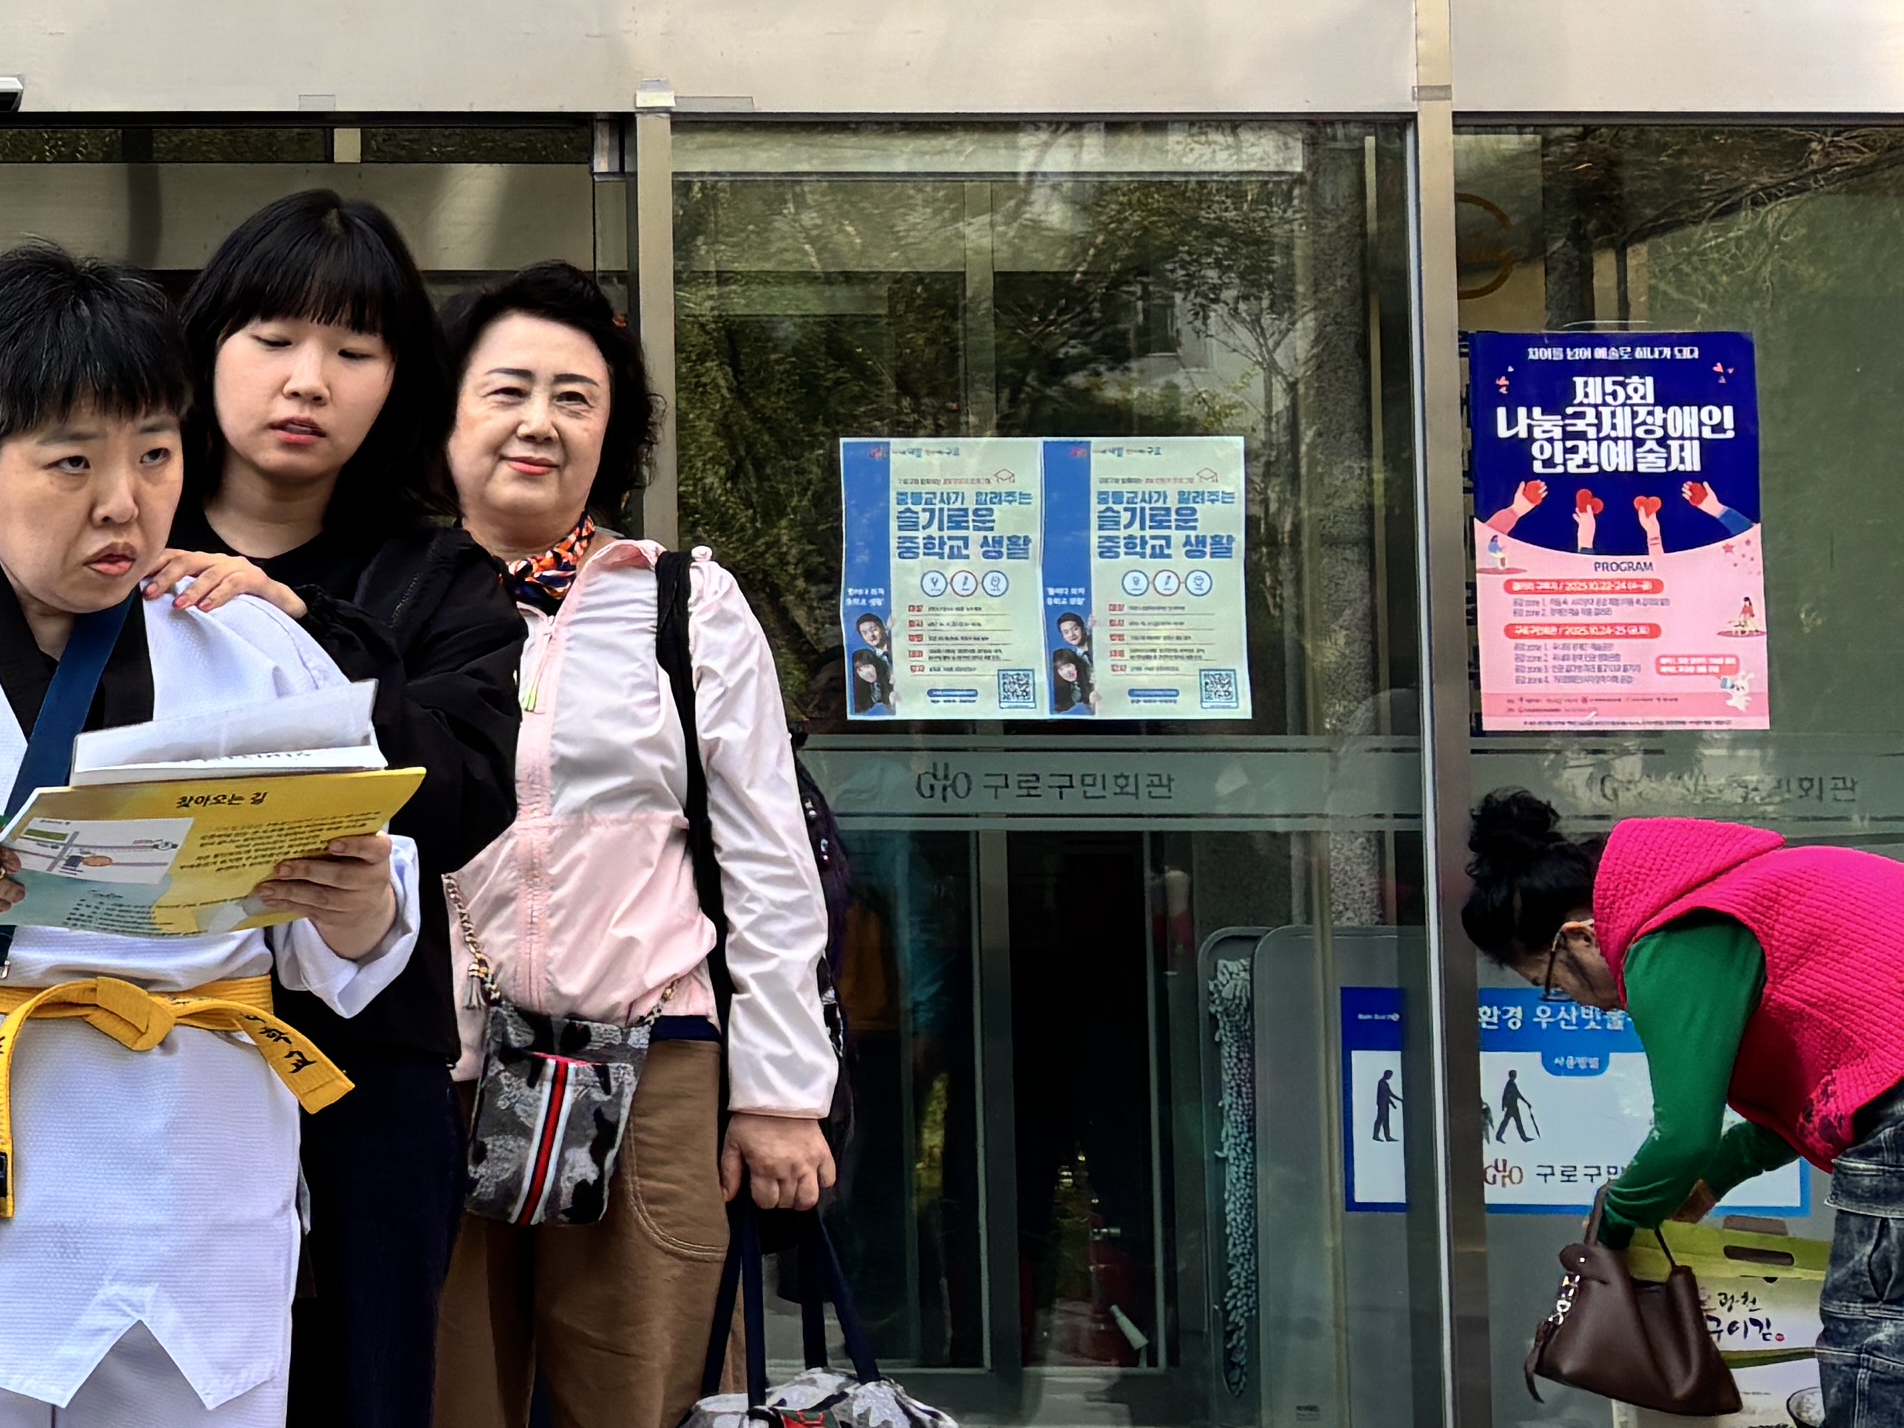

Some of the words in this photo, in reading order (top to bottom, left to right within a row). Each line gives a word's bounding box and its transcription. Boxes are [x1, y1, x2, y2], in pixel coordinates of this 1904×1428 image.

[1527, 346, 1564, 361] 차이를
[1566, 346, 1592, 361] 넘어
[1593, 346, 1633, 360] 예술로
[1634, 346, 1672, 360] 하나가
[1673, 346, 1700, 360] 되다
[1572, 375, 1655, 405] 제5회
[1496, 405, 1736, 440] 나눔국제장애인
[1531, 439, 1702, 473] 인권예술제
[896, 507, 996, 532] 슬기로운
[1096, 506, 1199, 532] 슬기로운
[896, 534, 971, 560] 중학교
[979, 534, 1032, 560] 생활
[1096, 534, 1173, 560] 중학교
[1182, 534, 1236, 560] 생활
[1594, 561, 1654, 573] PROGRAM
[175, 792, 245, 809] 찾아오는
[250, 791, 269, 805] 길
[980, 769, 1175, 805] 구로구민회관
[1478, 1005, 1523, 1030] 환경
[1535, 1164, 1627, 1184] 구로구민
[1705, 1314, 1773, 1342] 구이김
